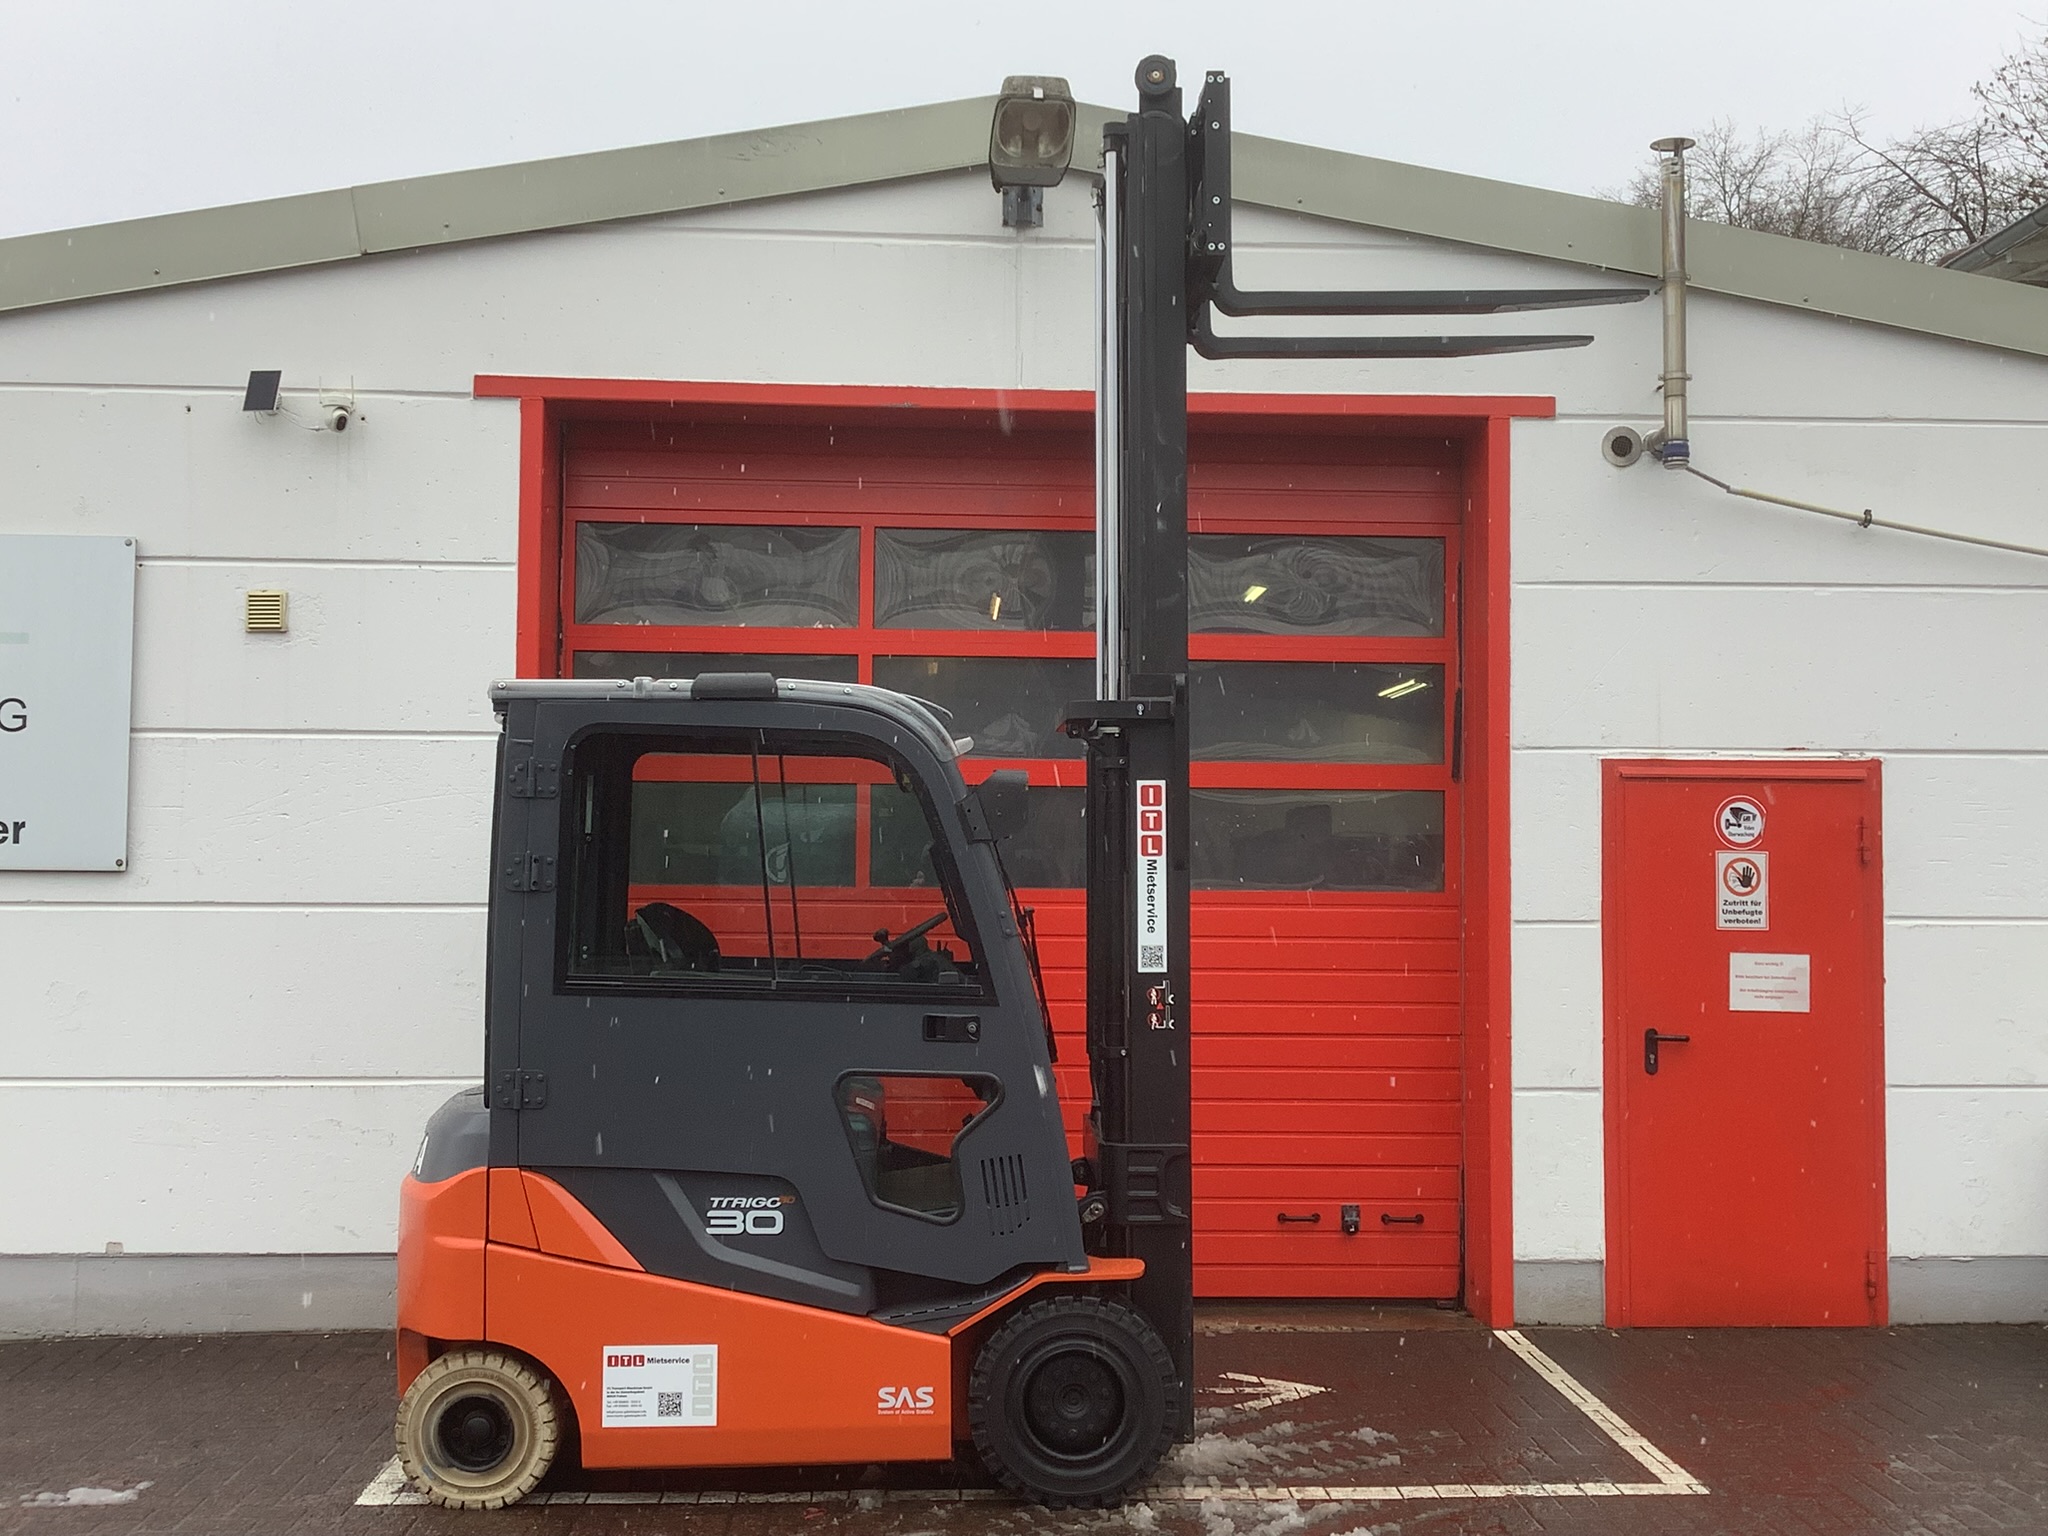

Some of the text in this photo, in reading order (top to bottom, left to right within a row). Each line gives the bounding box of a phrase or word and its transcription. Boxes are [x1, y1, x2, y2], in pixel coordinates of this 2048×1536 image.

[1143, 786, 1160, 855] ITL
[1147, 859, 1157, 933] Mietservice
[1722, 909, 1763, 917] Unbefugte
[705, 1210, 784, 1235] 30
[609, 1356, 643, 1366] ITL
[878, 1386, 934, 1408] SAS
